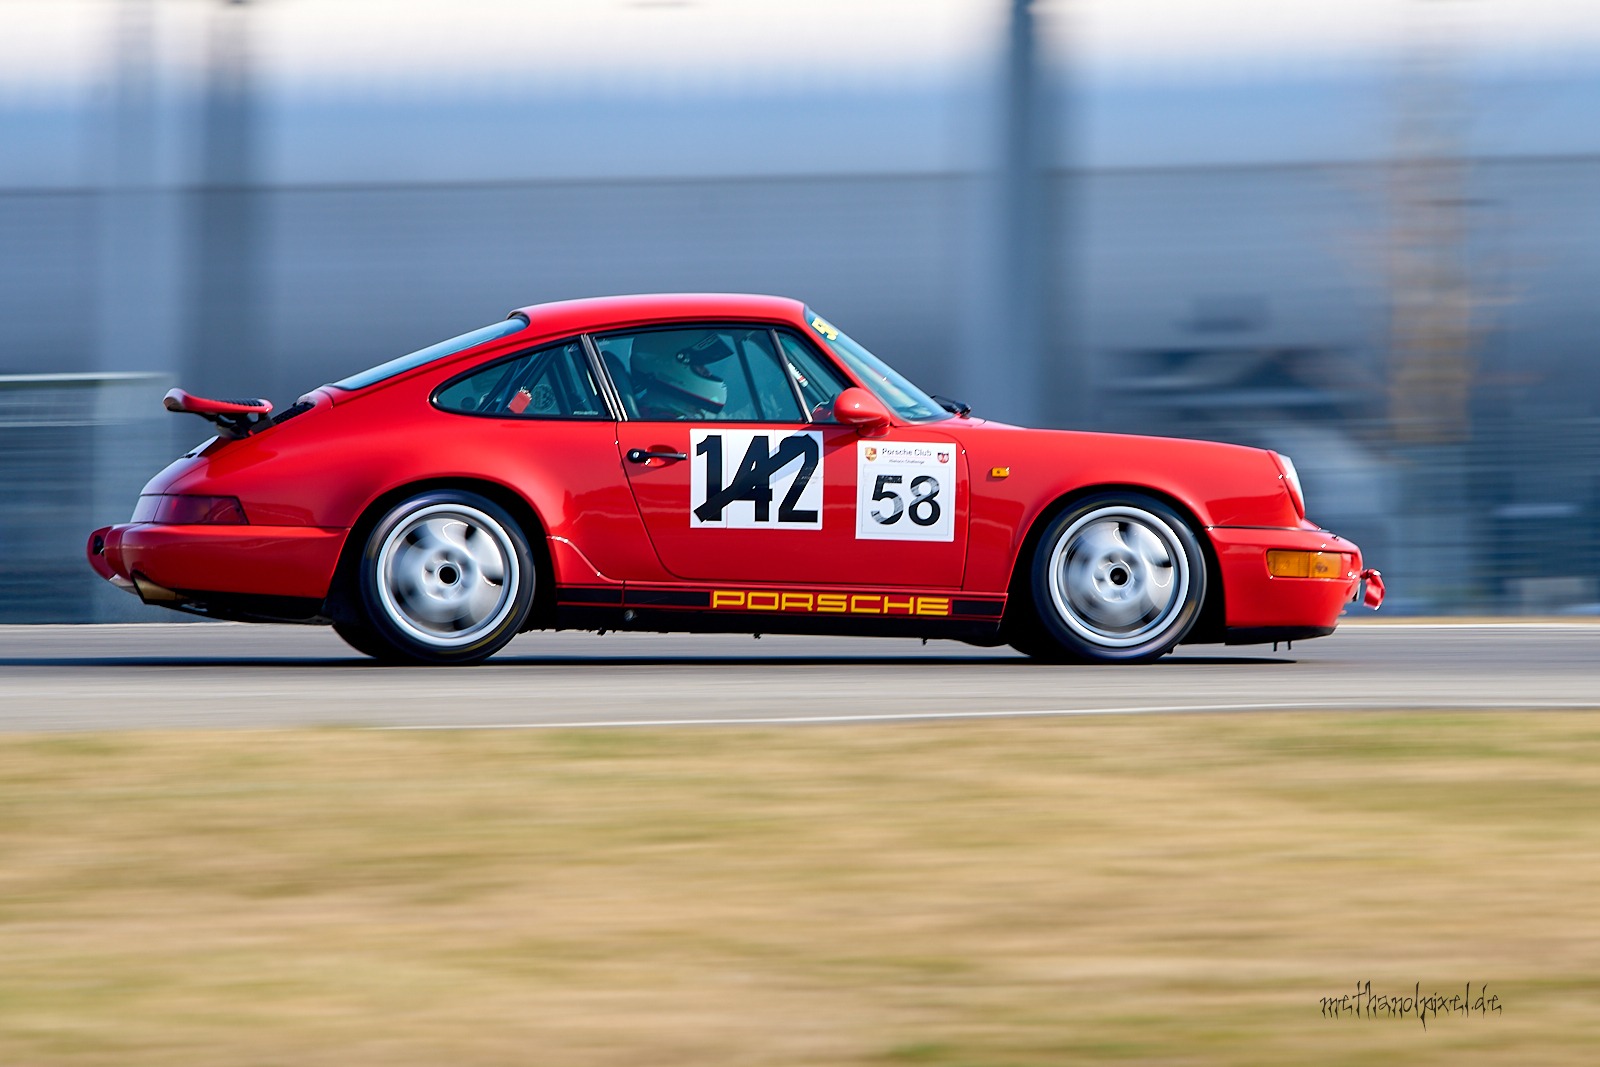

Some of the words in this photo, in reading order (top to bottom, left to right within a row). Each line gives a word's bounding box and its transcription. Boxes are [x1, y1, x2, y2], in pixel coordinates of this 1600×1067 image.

[882, 447, 913, 456] Porsche
[914, 448, 932, 457] Club
[694, 434, 819, 523] 142
[870, 474, 941, 527] 58
[712, 590, 949, 616] PORSCHE
